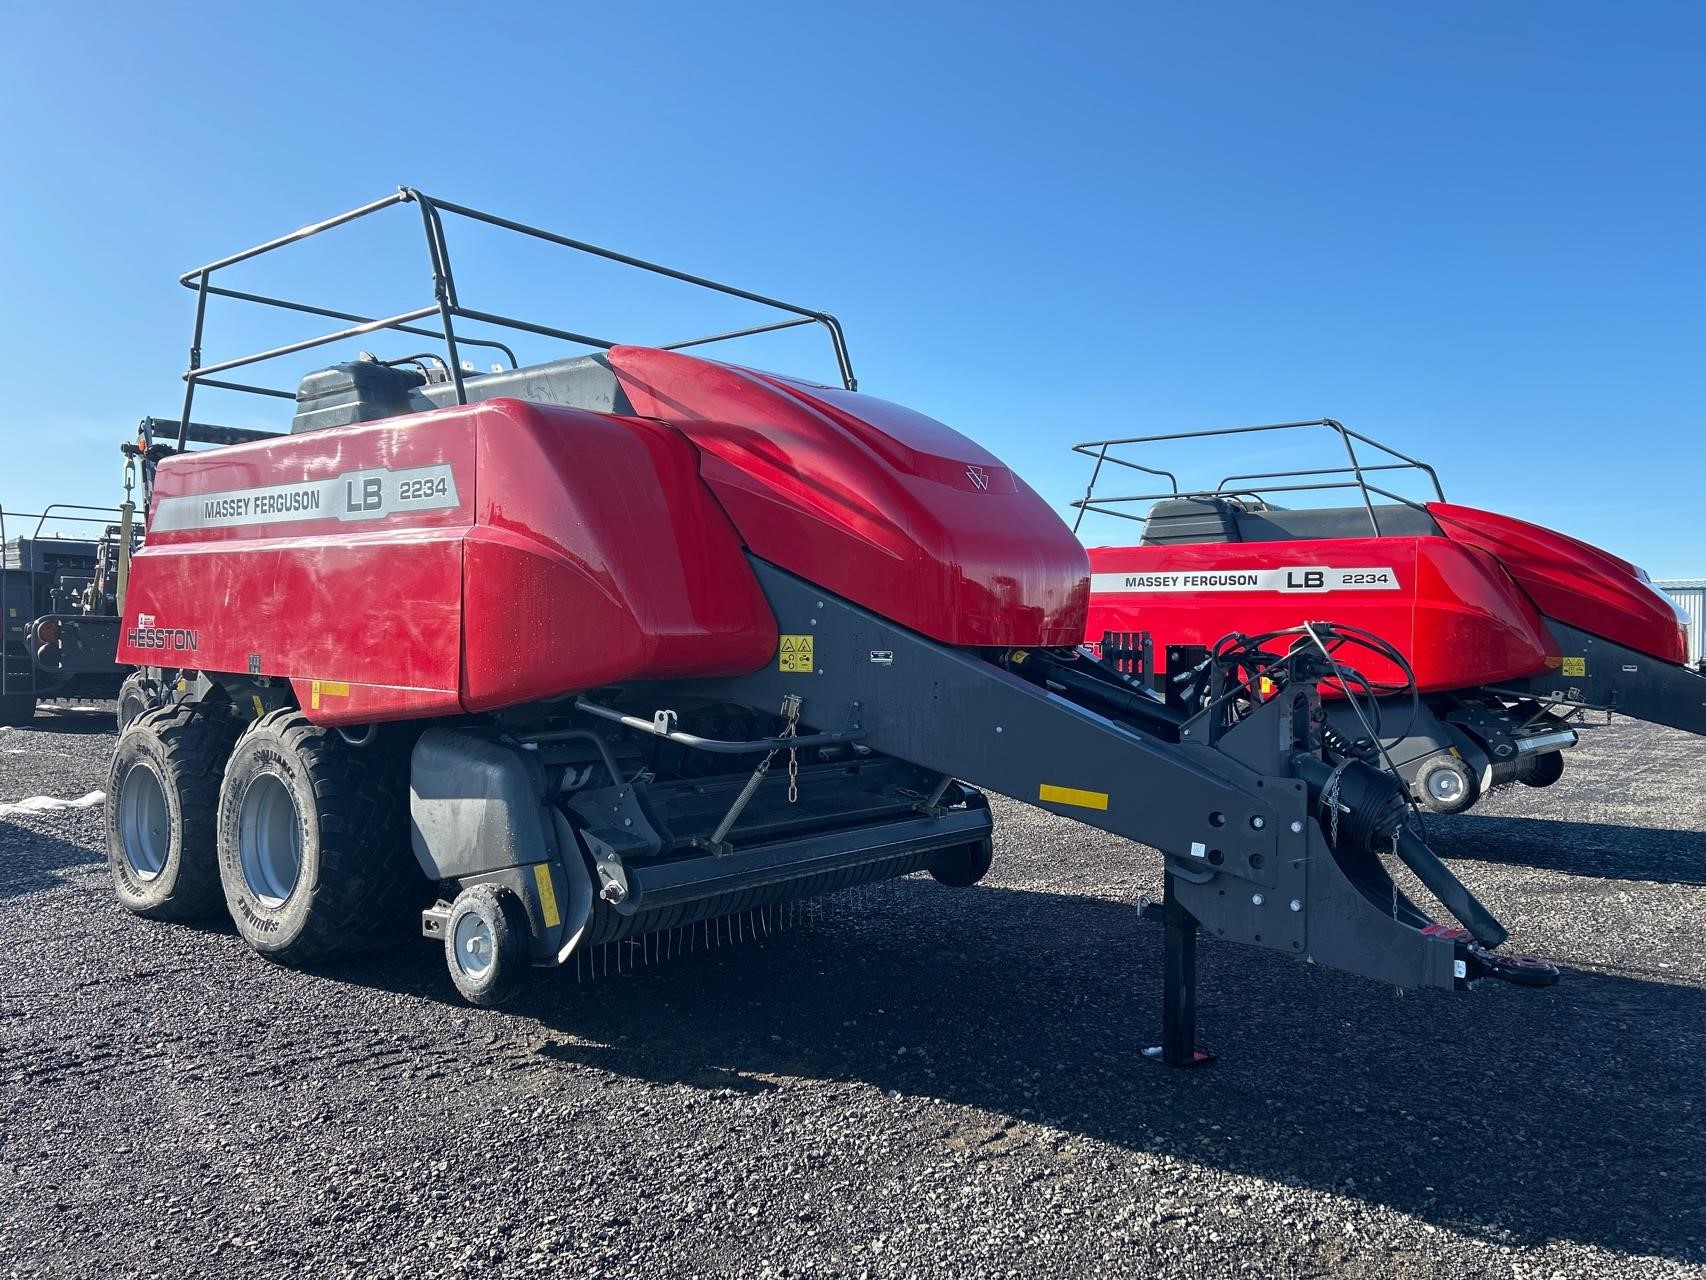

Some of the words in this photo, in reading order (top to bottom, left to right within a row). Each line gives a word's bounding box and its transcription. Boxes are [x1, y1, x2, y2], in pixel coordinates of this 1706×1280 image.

[204, 497, 251, 519] MASSEY
[253, 490, 320, 515] FERGUSON
[346, 477, 383, 513] LB
[399, 477, 448, 500] 2234
[1125, 576, 1179, 588] MASSEY
[1183, 575, 1258, 587] FERGUSON
[1286, 571, 1324, 589] LB
[1341, 573, 1389, 585] 2234
[127, 628, 198, 651] HESSTON
